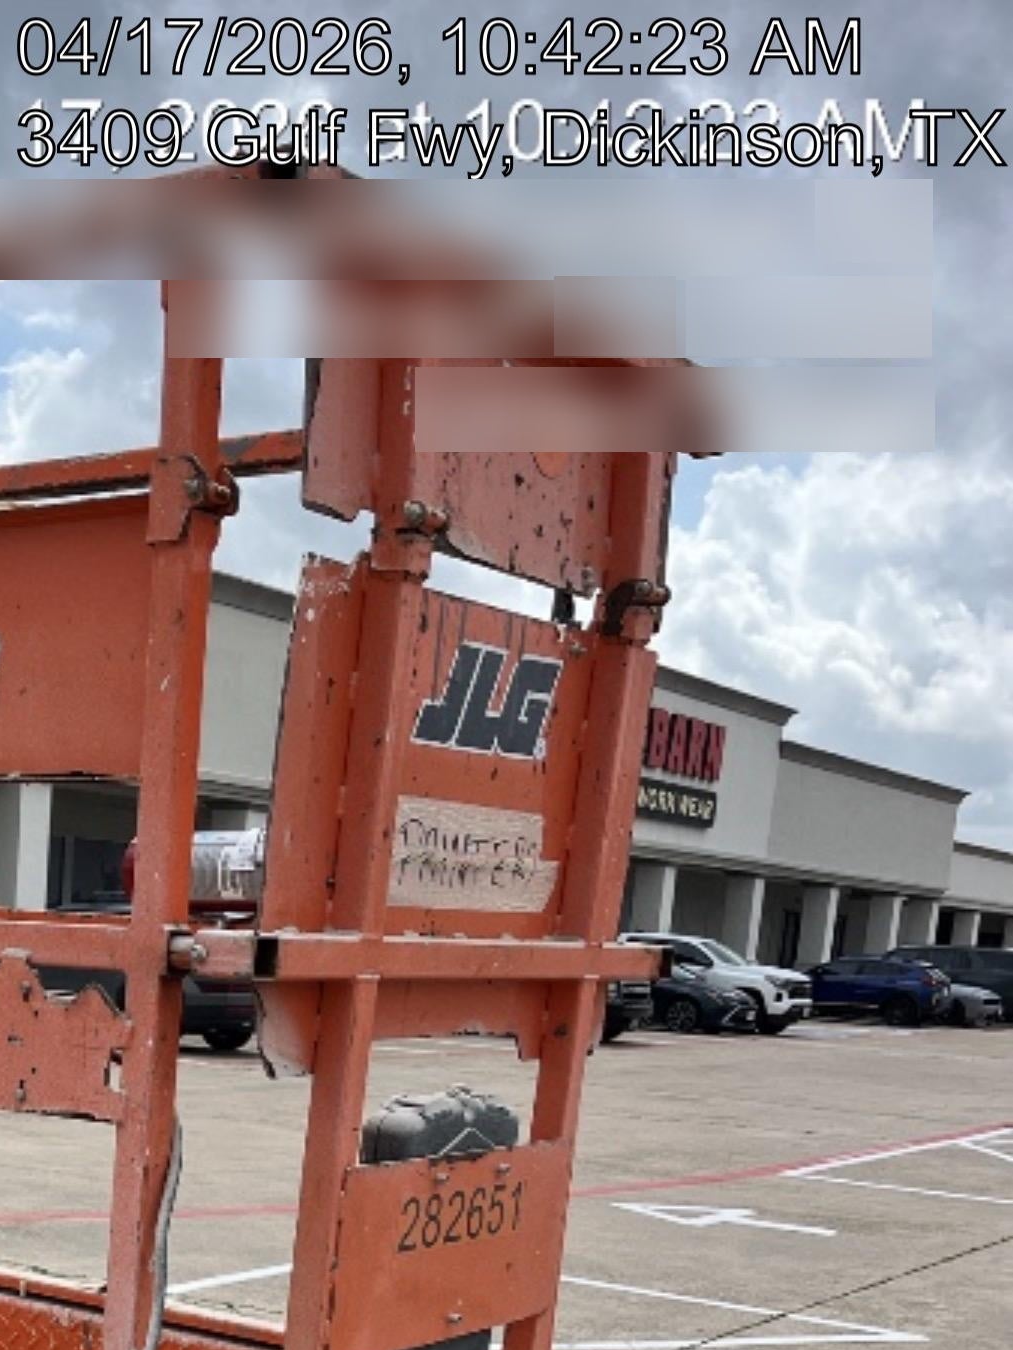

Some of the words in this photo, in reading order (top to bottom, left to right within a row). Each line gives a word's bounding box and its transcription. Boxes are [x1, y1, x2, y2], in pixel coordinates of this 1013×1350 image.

[410, 639, 564, 760] JLG
[644, 708, 726, 783] BARN
[397, 1180, 523, 1254] 282651
